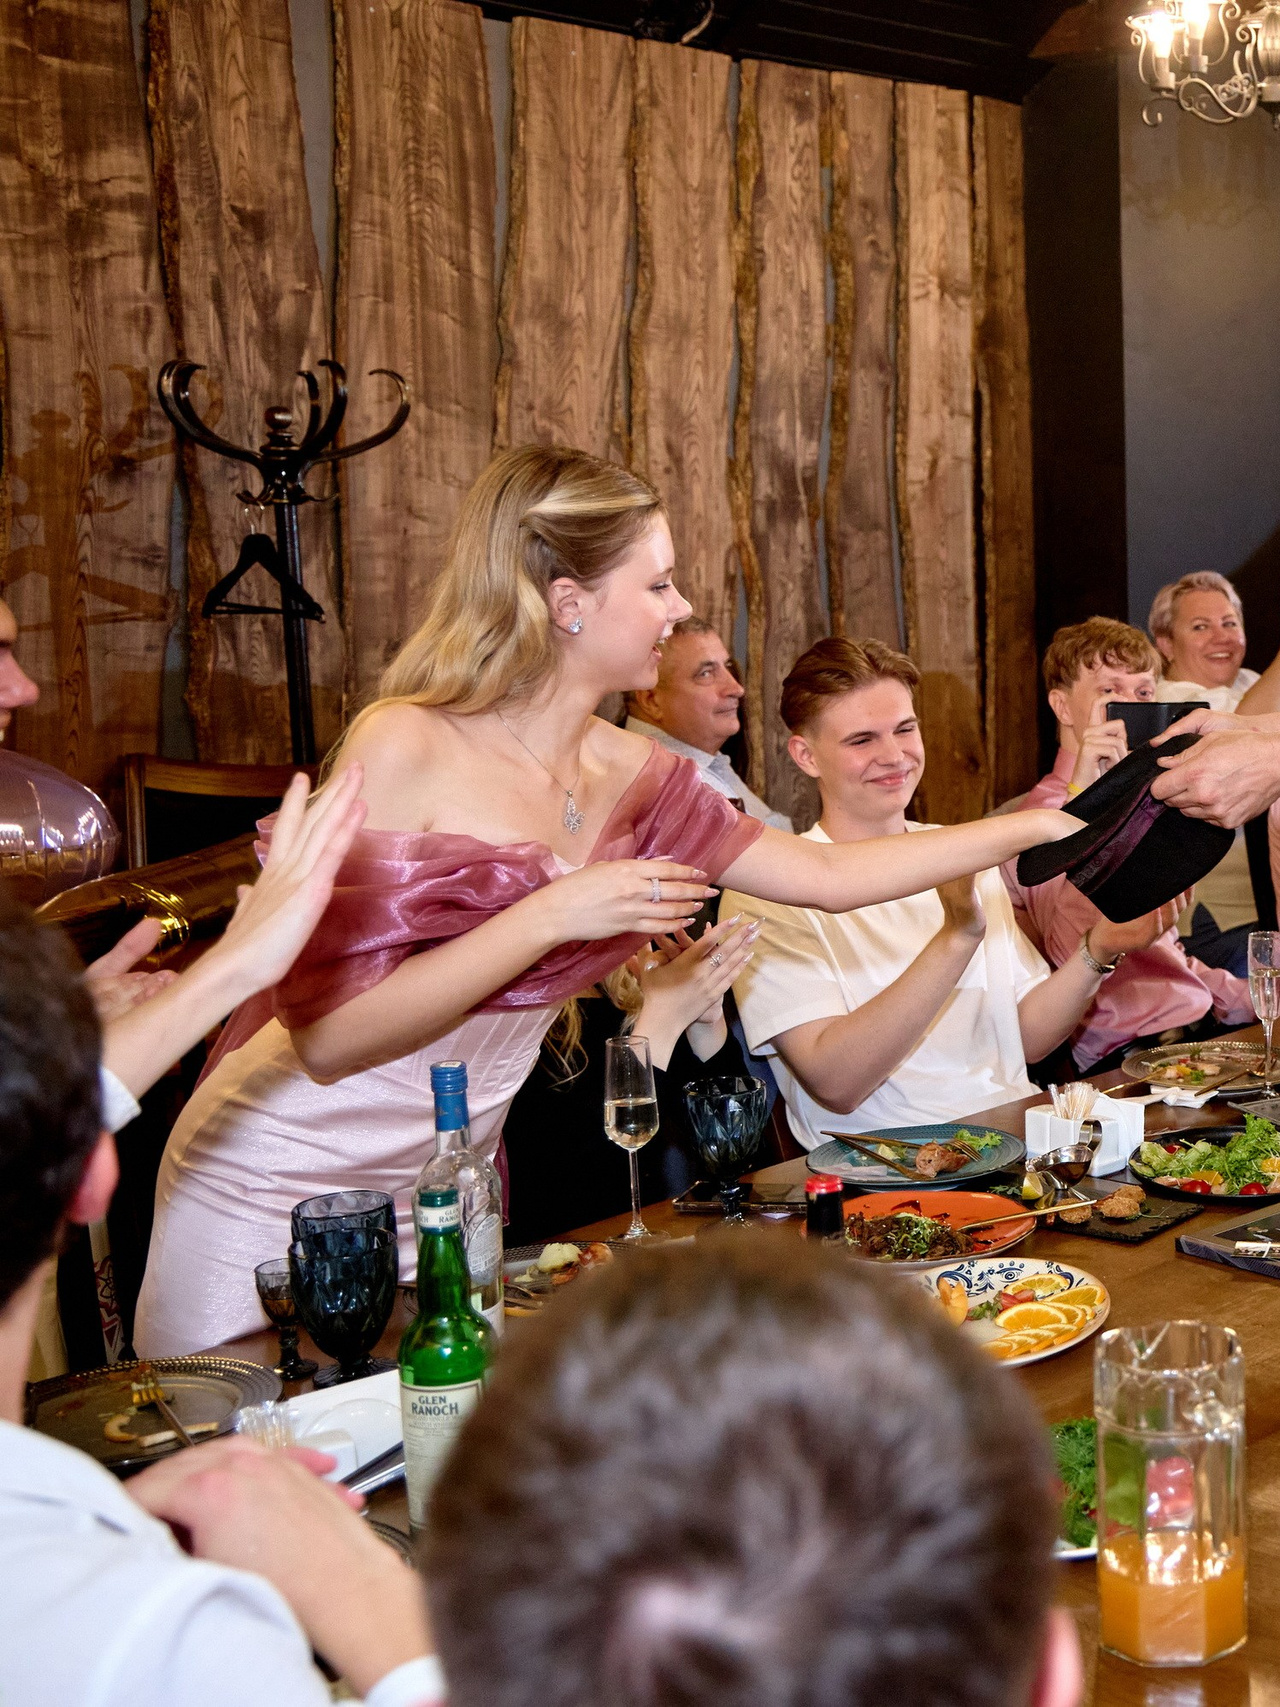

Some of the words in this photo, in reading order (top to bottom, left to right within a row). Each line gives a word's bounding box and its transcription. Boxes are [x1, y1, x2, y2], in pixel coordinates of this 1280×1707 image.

[438, 1213, 460, 1224] RANOC
[418, 1395, 447, 1405] GLEN
[411, 1402, 459, 1416] RANOCH
